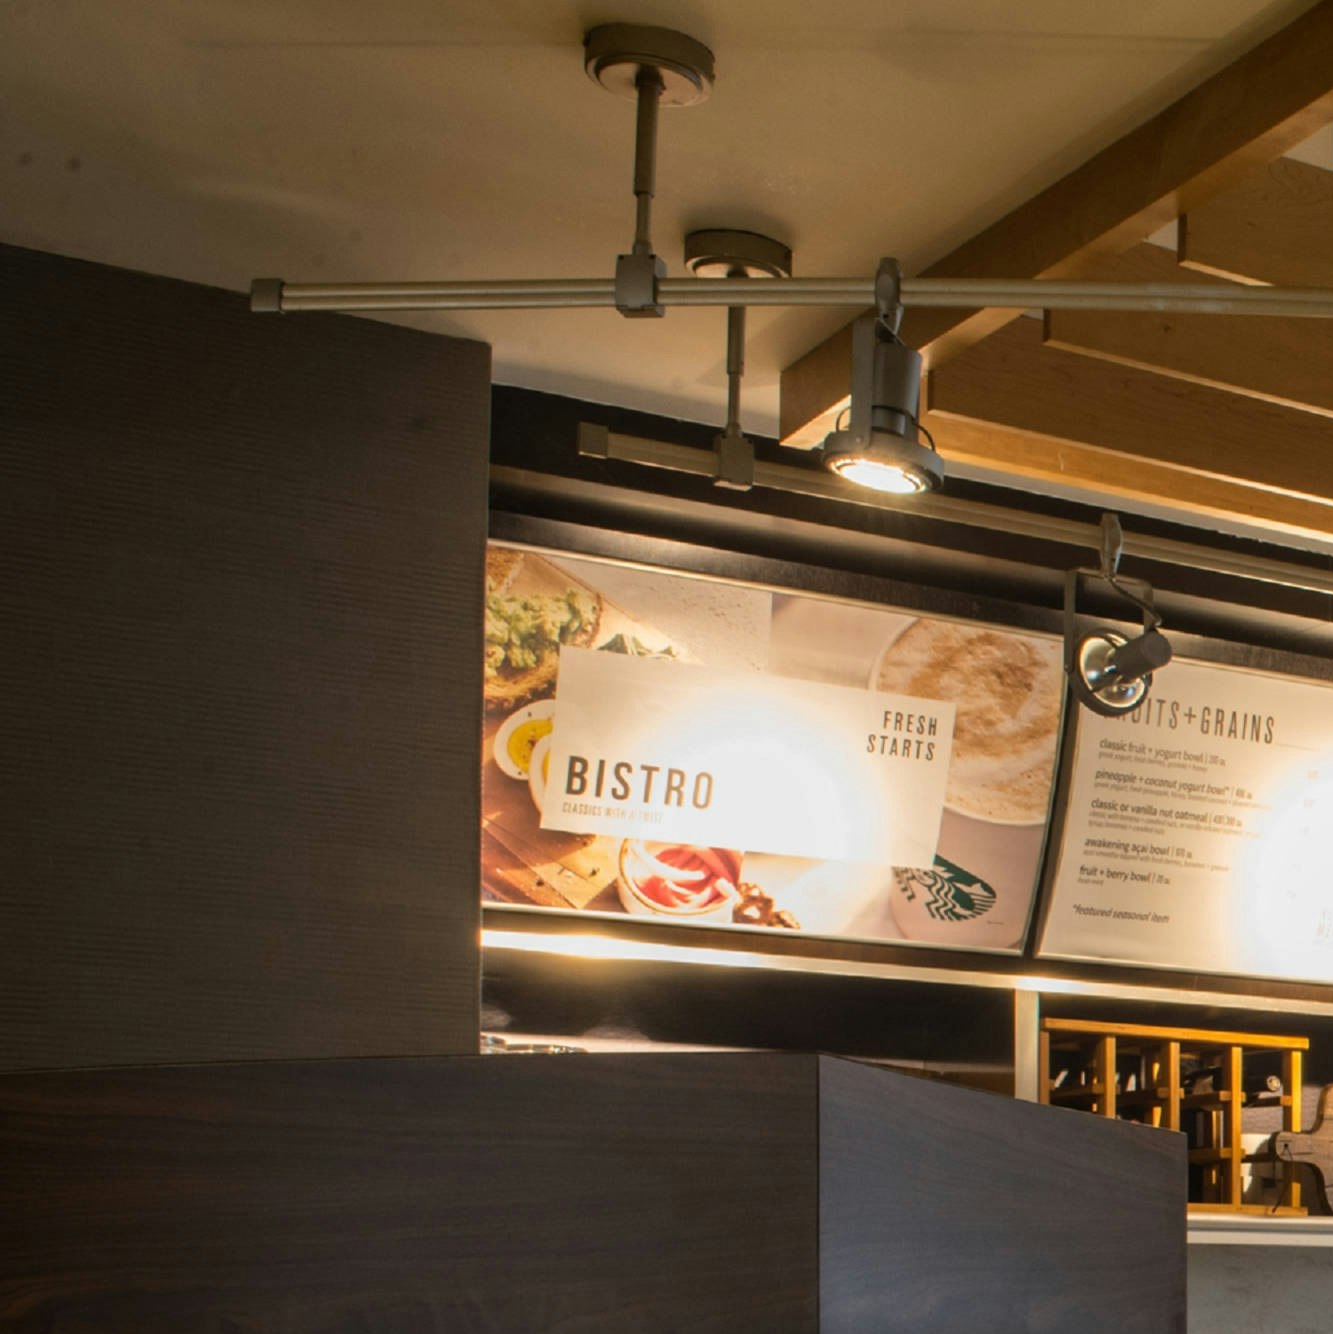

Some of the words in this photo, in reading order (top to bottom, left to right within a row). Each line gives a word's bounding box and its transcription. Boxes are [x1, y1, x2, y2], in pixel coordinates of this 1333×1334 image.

[882, 709, 939, 737] FRESH
[866, 733, 936, 761] STARTS
[1099, 738, 1127, 753] classic
[1155, 748, 1182, 763] yogurt
[564, 754, 715, 810] BISTRO
[1095, 769, 1137, 784] pineapple
[561, 802, 603, 817] CLASSICS
[1091, 798, 1119, 811] classic
[1130, 803, 1158, 816] vanilla
